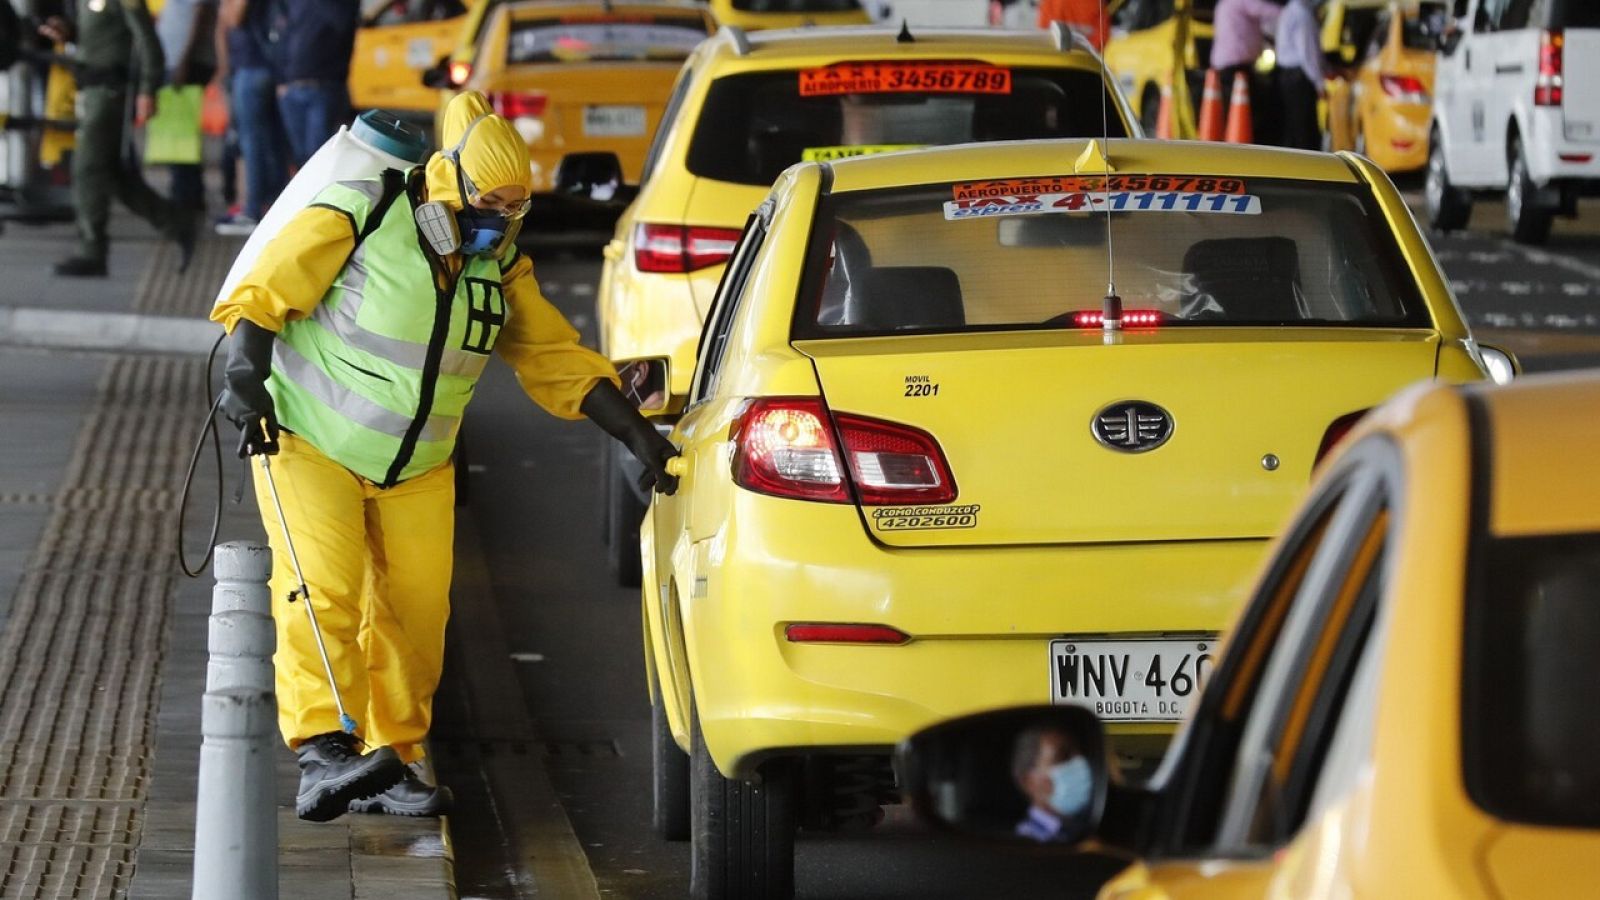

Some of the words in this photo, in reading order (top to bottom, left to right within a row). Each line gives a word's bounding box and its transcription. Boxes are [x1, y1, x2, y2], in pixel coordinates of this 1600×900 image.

[889, 69, 1005, 89] 3456789
[958, 184, 1062, 198] AEROPUERTO
[1079, 176, 1240, 192] 3456789
[905, 375, 930, 383] MOVIL
[904, 384, 939, 396] 2201
[882, 516, 971, 528] 4202600
[1057, 654, 1130, 697] WNV
[1096, 701, 1149, 714] BOGOTA
[1159, 701, 1183, 715] D.C.
